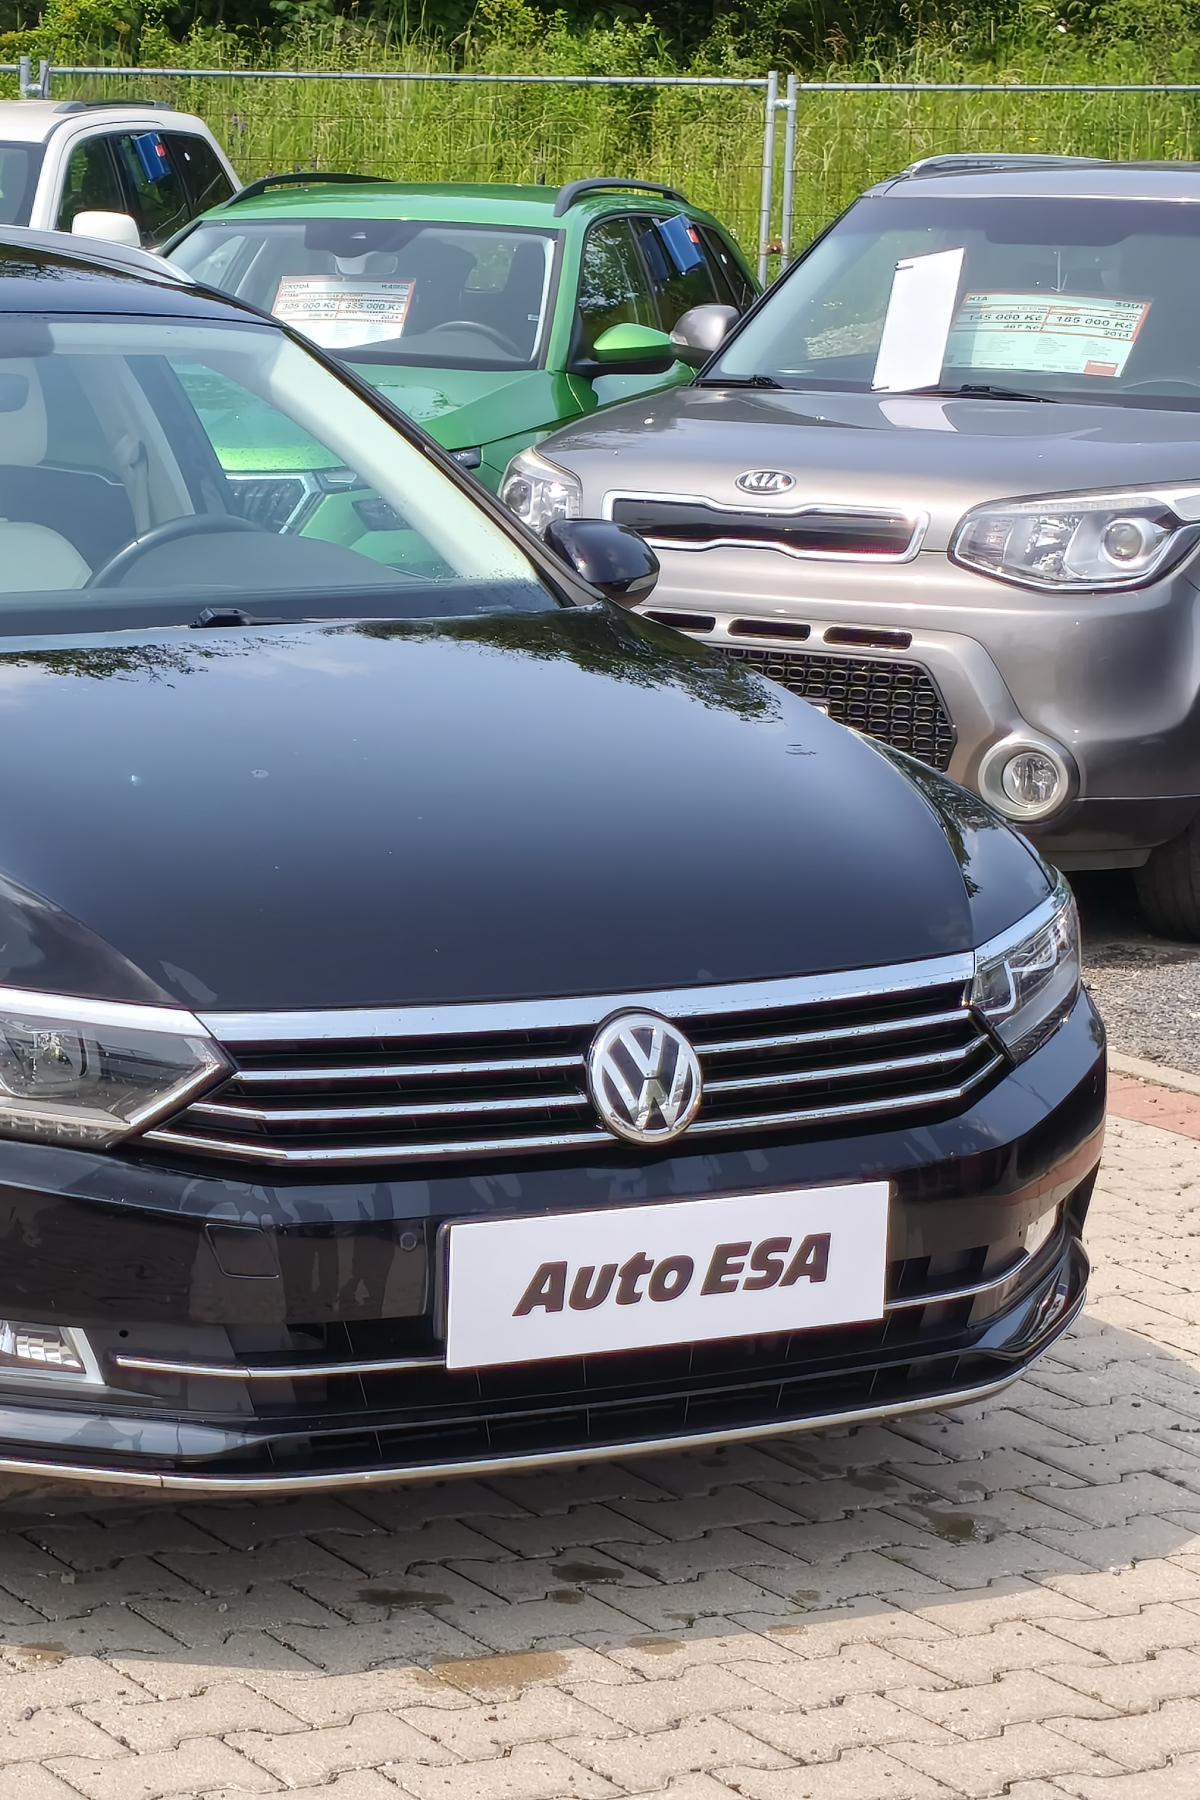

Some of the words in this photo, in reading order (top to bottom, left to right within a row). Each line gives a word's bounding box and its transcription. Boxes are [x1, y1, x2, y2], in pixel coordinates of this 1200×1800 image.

[1085, 318, 1111, 327] 000
[743, 472, 786, 489] KIA
[511, 1251, 695, 1317] Auto
[700, 1232, 832, 1296] ESA
